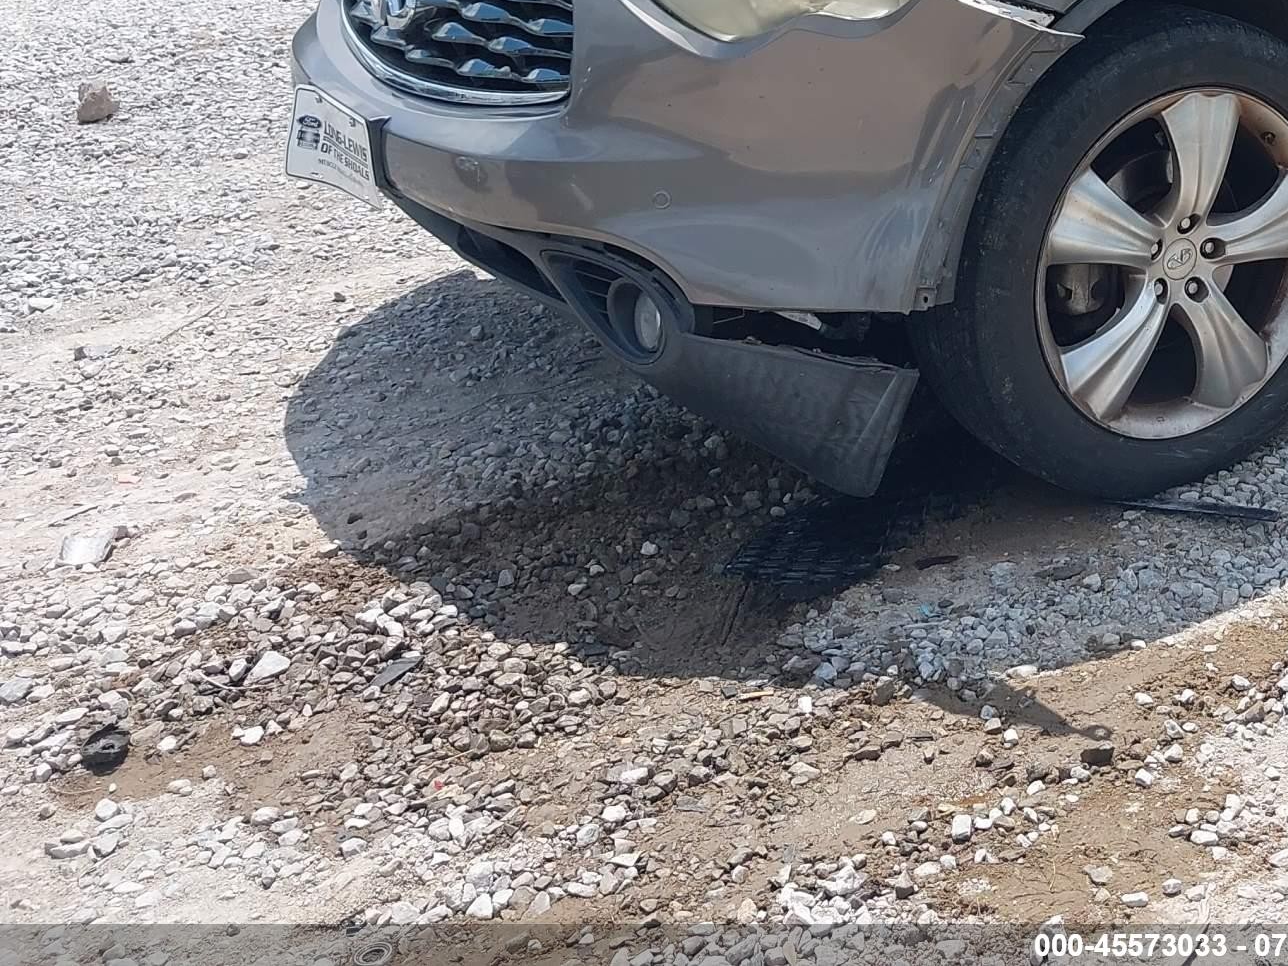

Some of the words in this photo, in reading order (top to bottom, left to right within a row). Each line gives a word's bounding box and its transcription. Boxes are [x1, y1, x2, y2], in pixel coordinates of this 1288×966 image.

[301, 116, 320, 128] Ford
[323, 121, 368, 162] LONG-LEWIS
[321, 142, 333, 155] OF
[333, 149, 344, 164] THE
[344, 157, 370, 181] SHOALS
